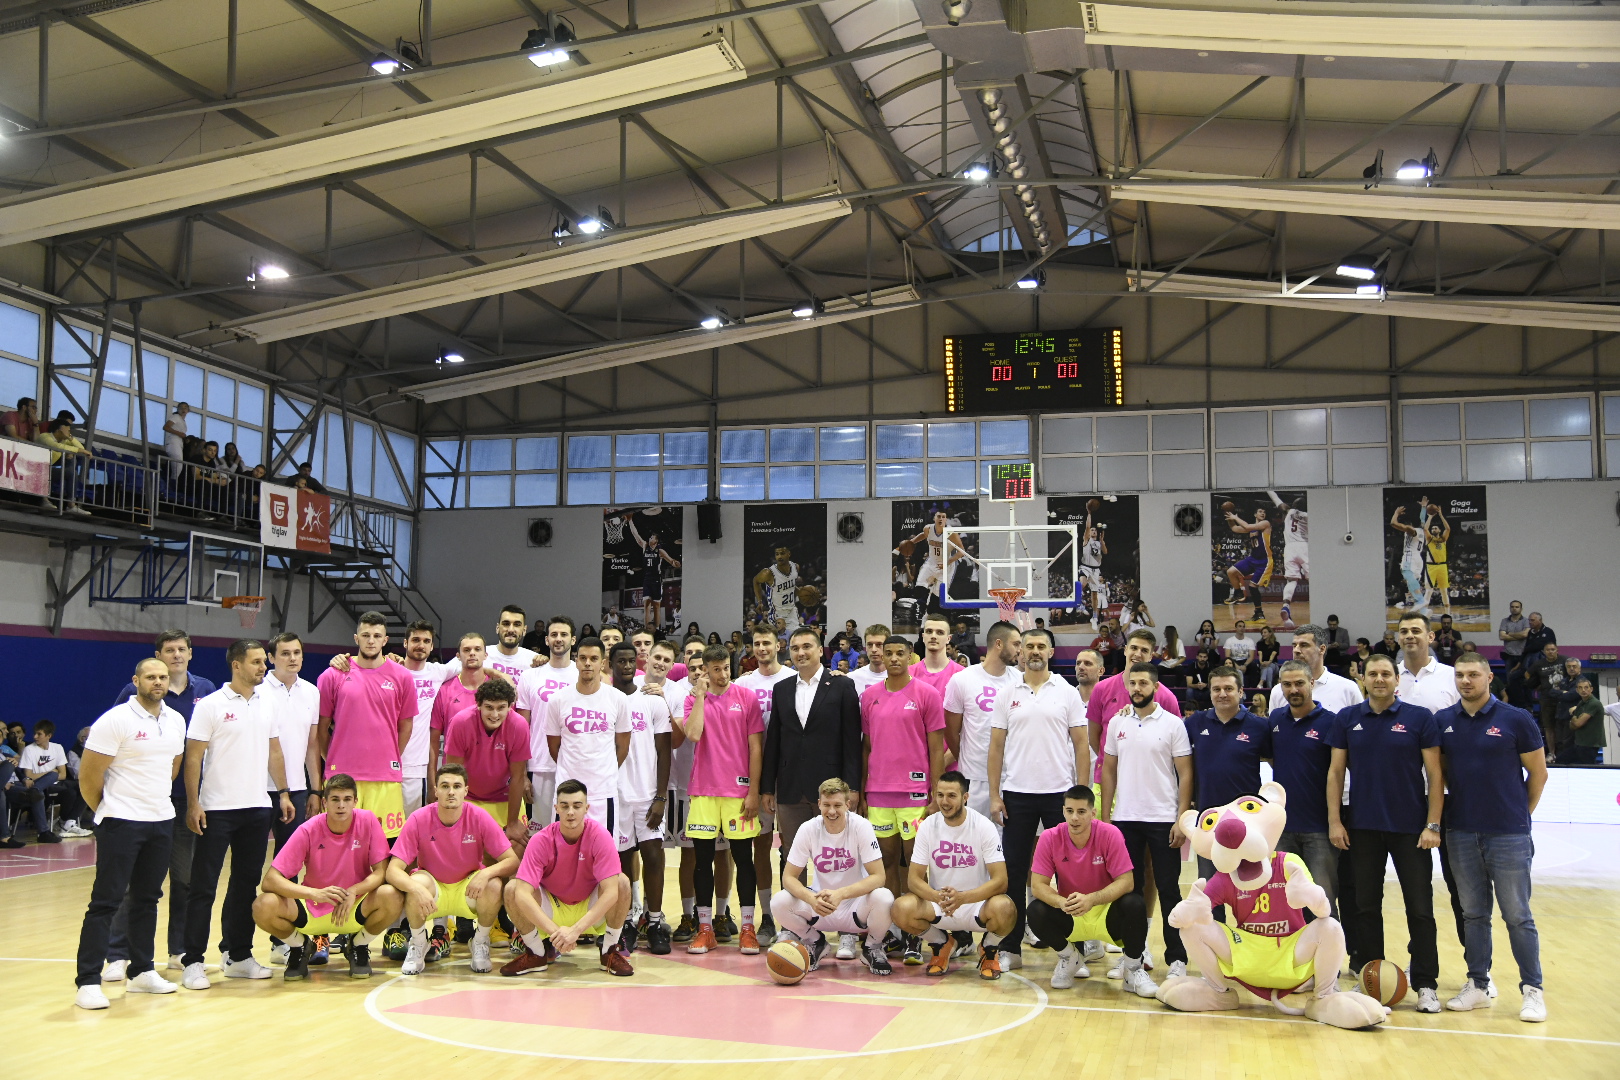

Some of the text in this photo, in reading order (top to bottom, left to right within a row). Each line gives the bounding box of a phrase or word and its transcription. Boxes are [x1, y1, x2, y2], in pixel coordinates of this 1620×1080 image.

[1014, 337, 1055, 354] 12:45
[989, 358, 1011, 366] HOME
[1053, 355, 1078, 364] GUEST
[992, 365, 1012, 382] 00
[1033, 367, 1037, 379] 1
[1057, 362, 1078, 379] 00
[1005, 478, 1032, 499] 00
[1450, 499, 1471, 507] Goga
[1450, 506, 1478, 514] Bitadze
[271, 526, 288, 538] triglav
[933, 547, 941, 557] 15
[492, 662, 524, 677] DEK
[415, 679, 433, 688] EKI
[755, 688, 773, 700] DE
[571, 706, 607, 721] DEKI
[631, 711, 644, 721] KI
[385, 811, 404, 831] 66
[821, 846, 852, 860] DEKI
[940, 840, 973, 855] DEKI
